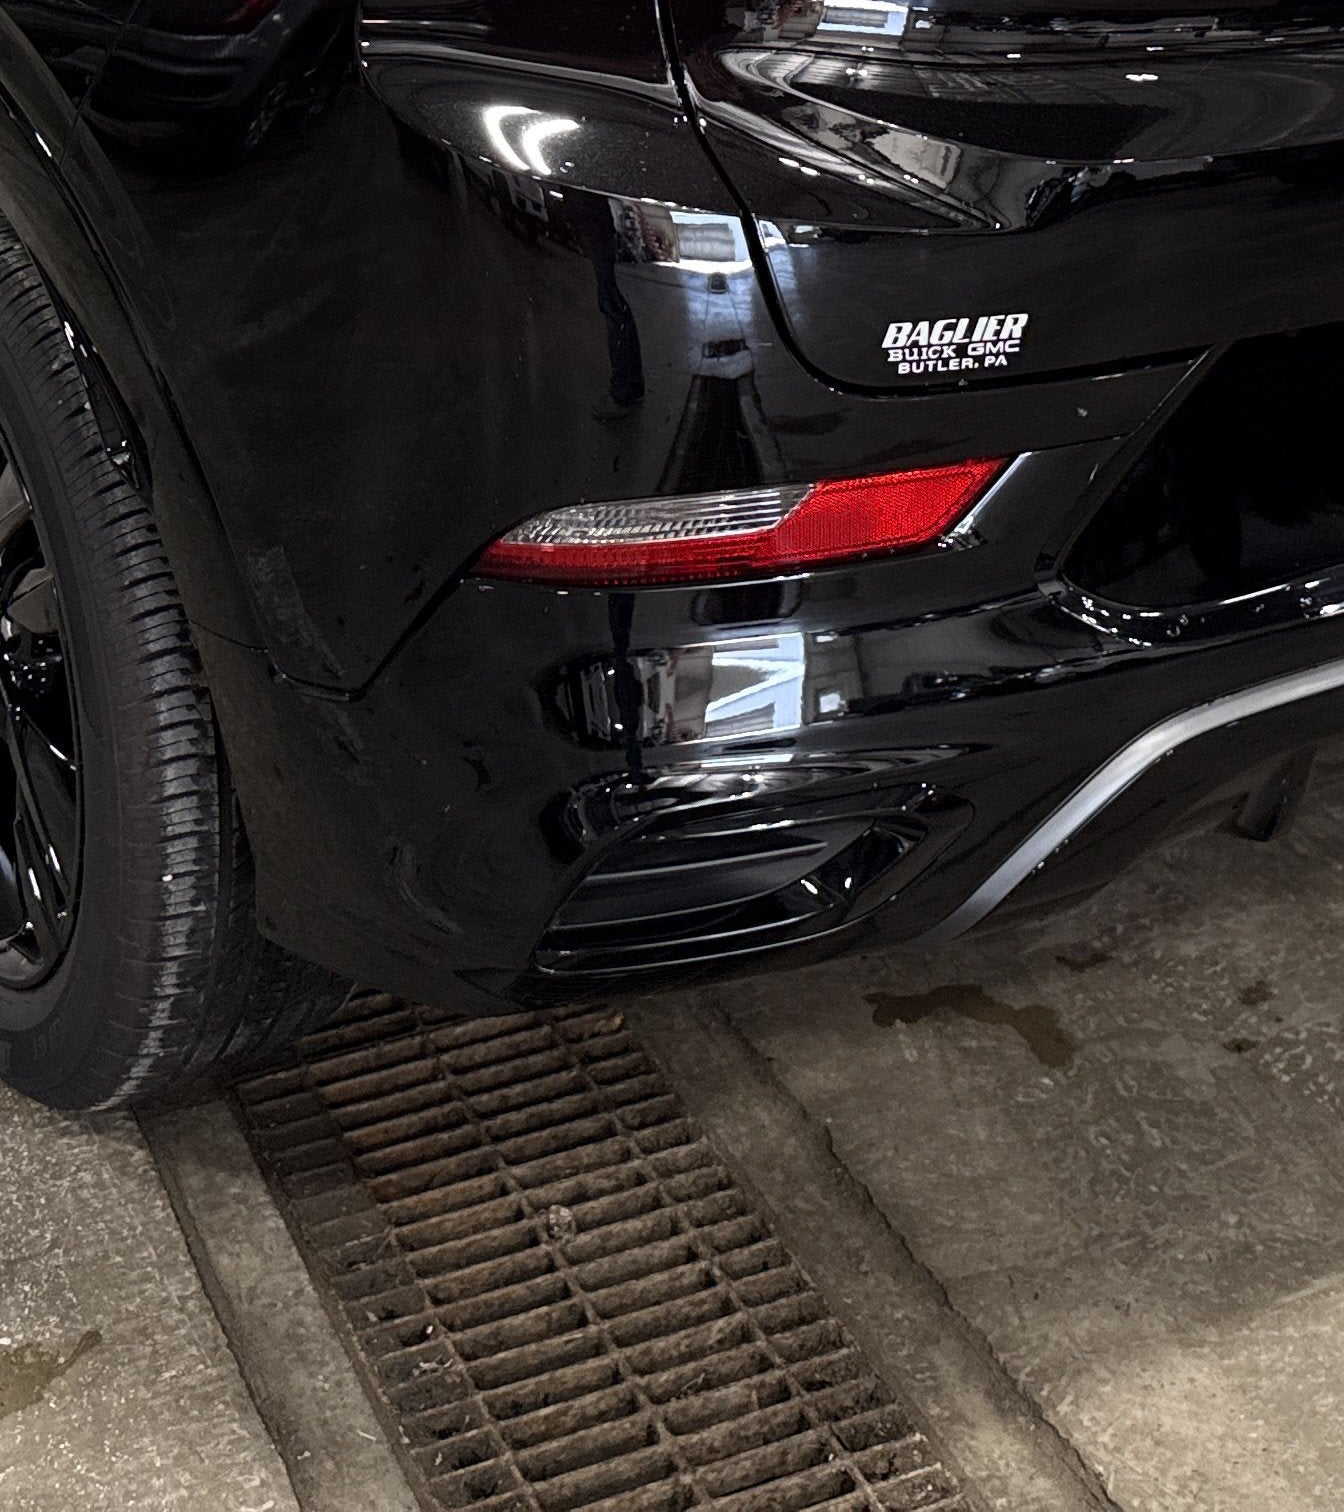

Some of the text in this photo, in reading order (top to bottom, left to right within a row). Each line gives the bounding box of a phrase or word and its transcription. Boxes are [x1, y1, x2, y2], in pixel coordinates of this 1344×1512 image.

[881, 313, 1029, 349] BAGLIER
[887, 339, 1021, 362] BUICK GMC
[984, 355, 1008, 368] PA
